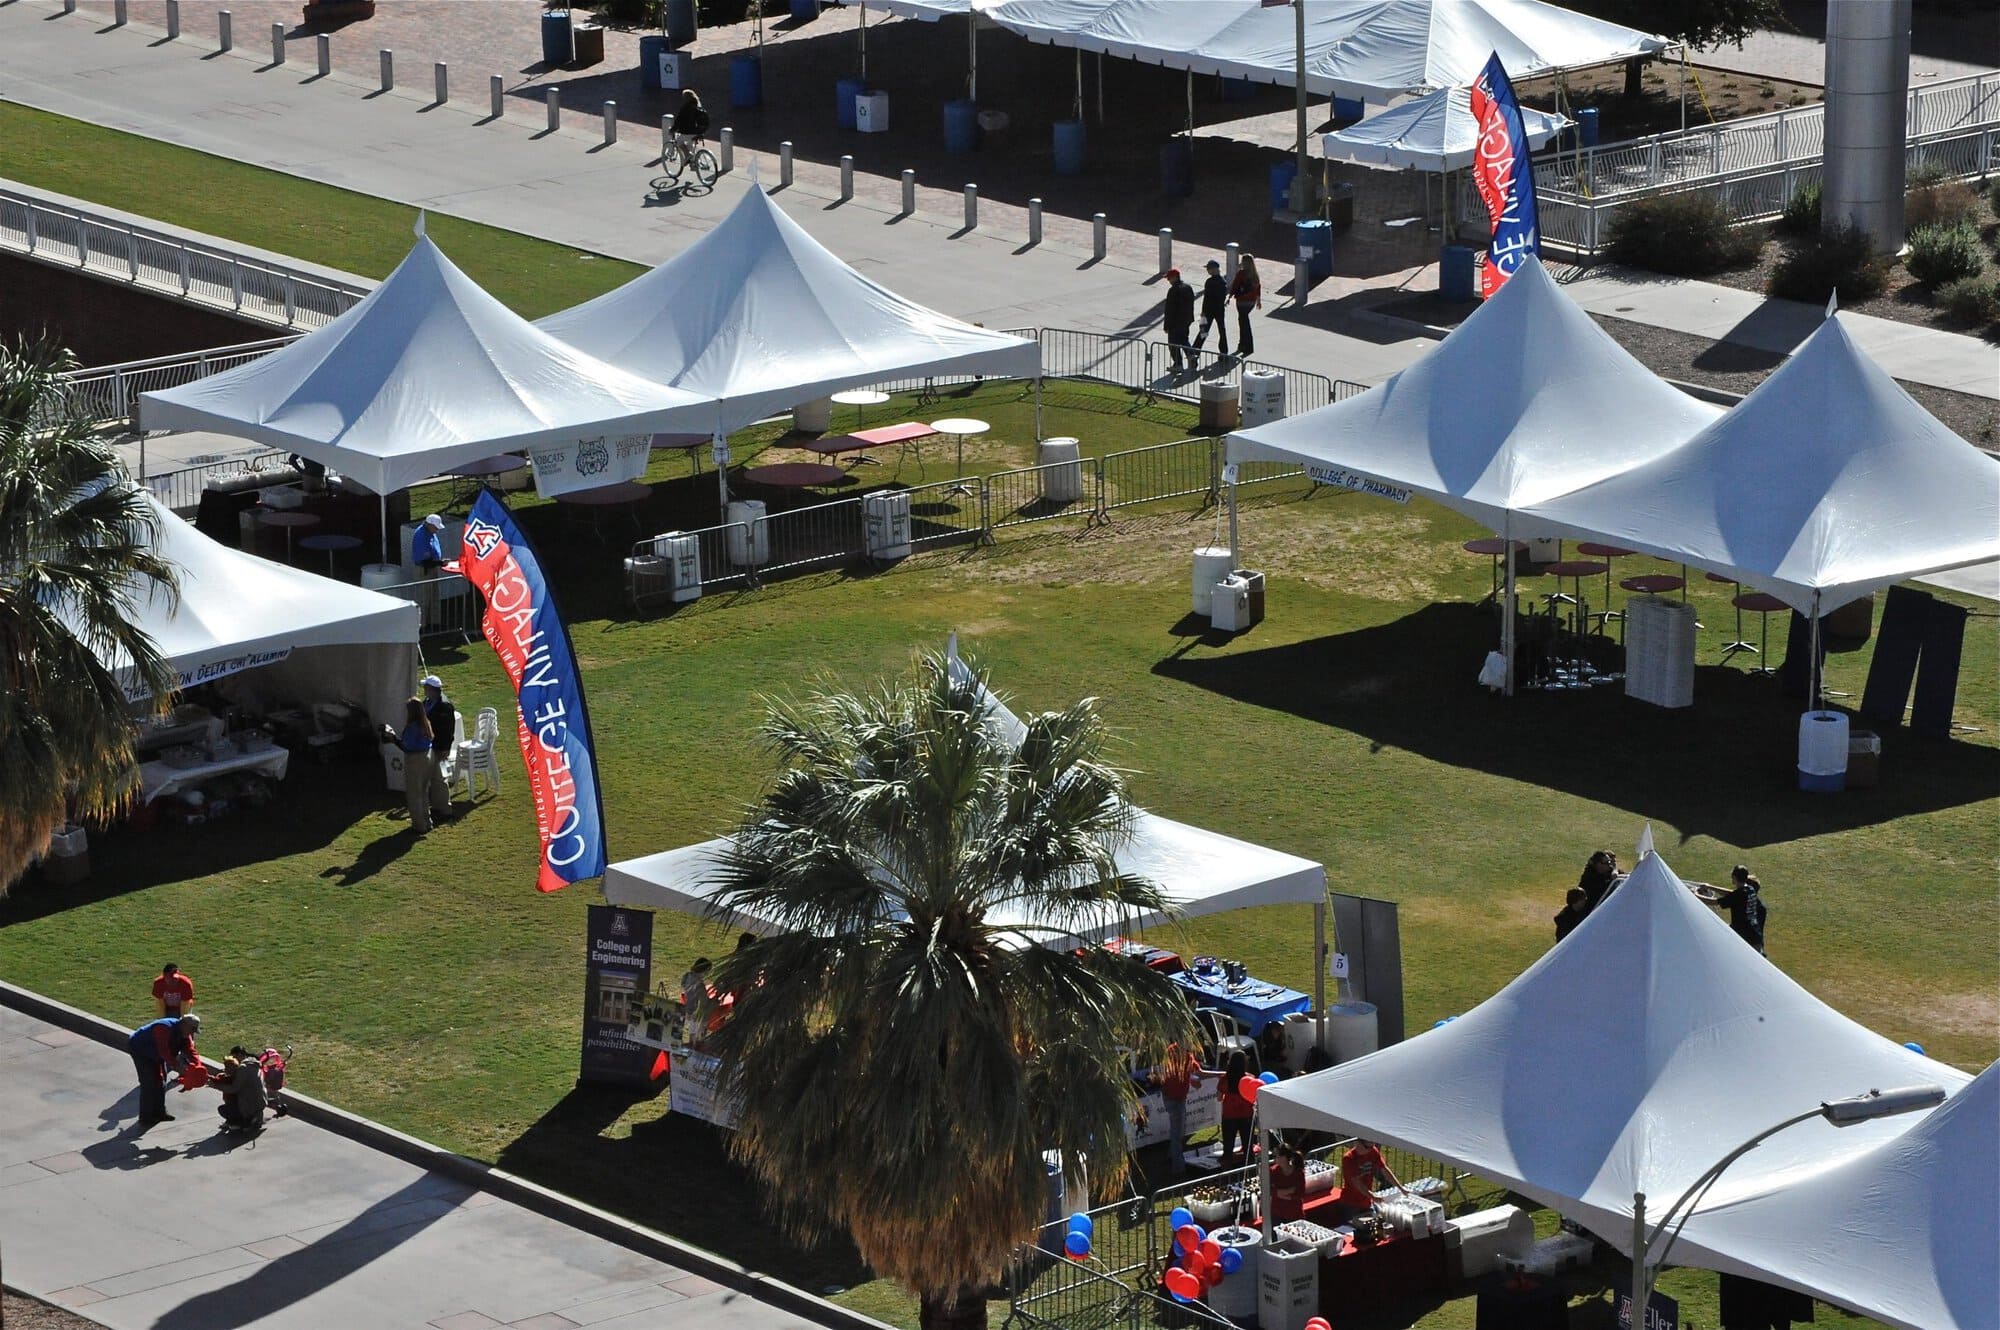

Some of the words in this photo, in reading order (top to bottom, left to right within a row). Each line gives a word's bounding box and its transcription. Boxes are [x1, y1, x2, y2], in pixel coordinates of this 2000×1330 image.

[1310, 467, 1343, 484] COLLEGE
[1346, 475, 1359, 487] OF
[1361, 479, 1408, 501] PHARMACY
[197, 662, 226, 681] DELTA
[249, 650, 289, 665] ALUMNI
[596, 938, 630, 954] College
[632, 944, 642, 954] of
[592, 950, 646, 969] Engineering
[1336, 958, 1344, 969] 5
